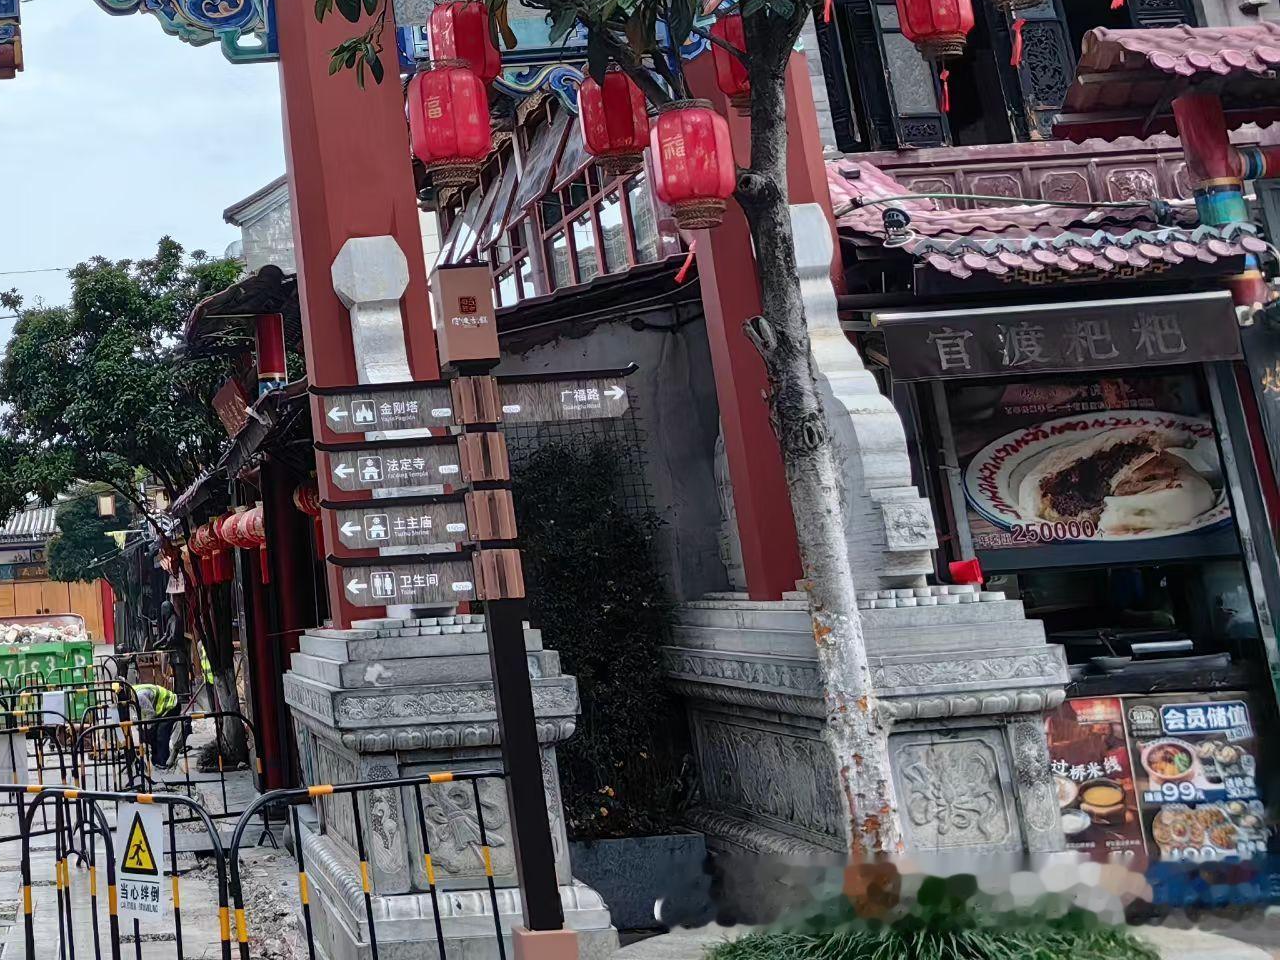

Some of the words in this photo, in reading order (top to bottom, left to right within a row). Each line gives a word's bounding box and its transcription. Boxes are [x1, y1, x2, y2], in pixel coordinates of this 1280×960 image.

[926, 311, 1189, 371] 官渡粑粑
[560, 388, 600, 403] 广福路
[379, 400, 418, 416] 金刚塔
[386, 457, 426, 472] 法定寺
[393, 515, 432, 531] 土主庙
[399, 573, 439, 589] 卫生间
[1163, 706, 1248, 729] 会员储值
[1051, 755, 1122, 781] 过桥米线
[120, 882, 160, 903] 当心绊倒
